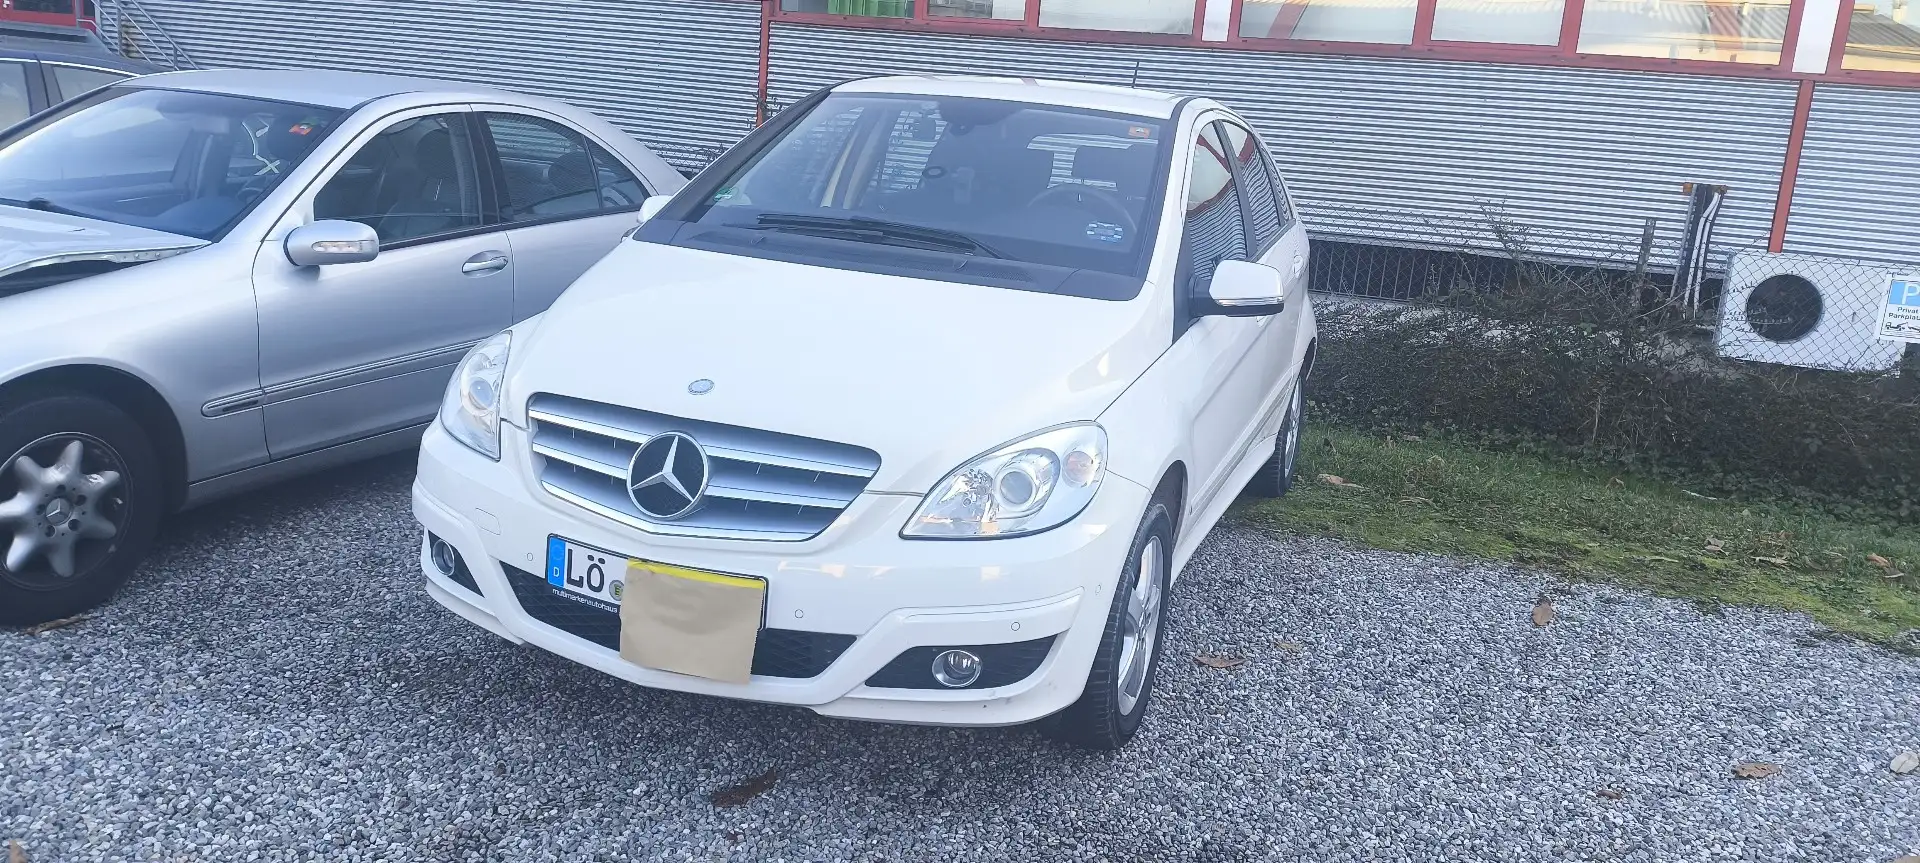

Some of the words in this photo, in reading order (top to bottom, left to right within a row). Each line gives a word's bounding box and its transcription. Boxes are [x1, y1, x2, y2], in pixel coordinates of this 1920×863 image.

[1901, 282, 1920, 305] P
[1897, 306, 1919, 314] Privat
[1888, 312, 1920, 321] Parkplat
[553, 566, 560, 578] D
[566, 548, 606, 593] LÖ
